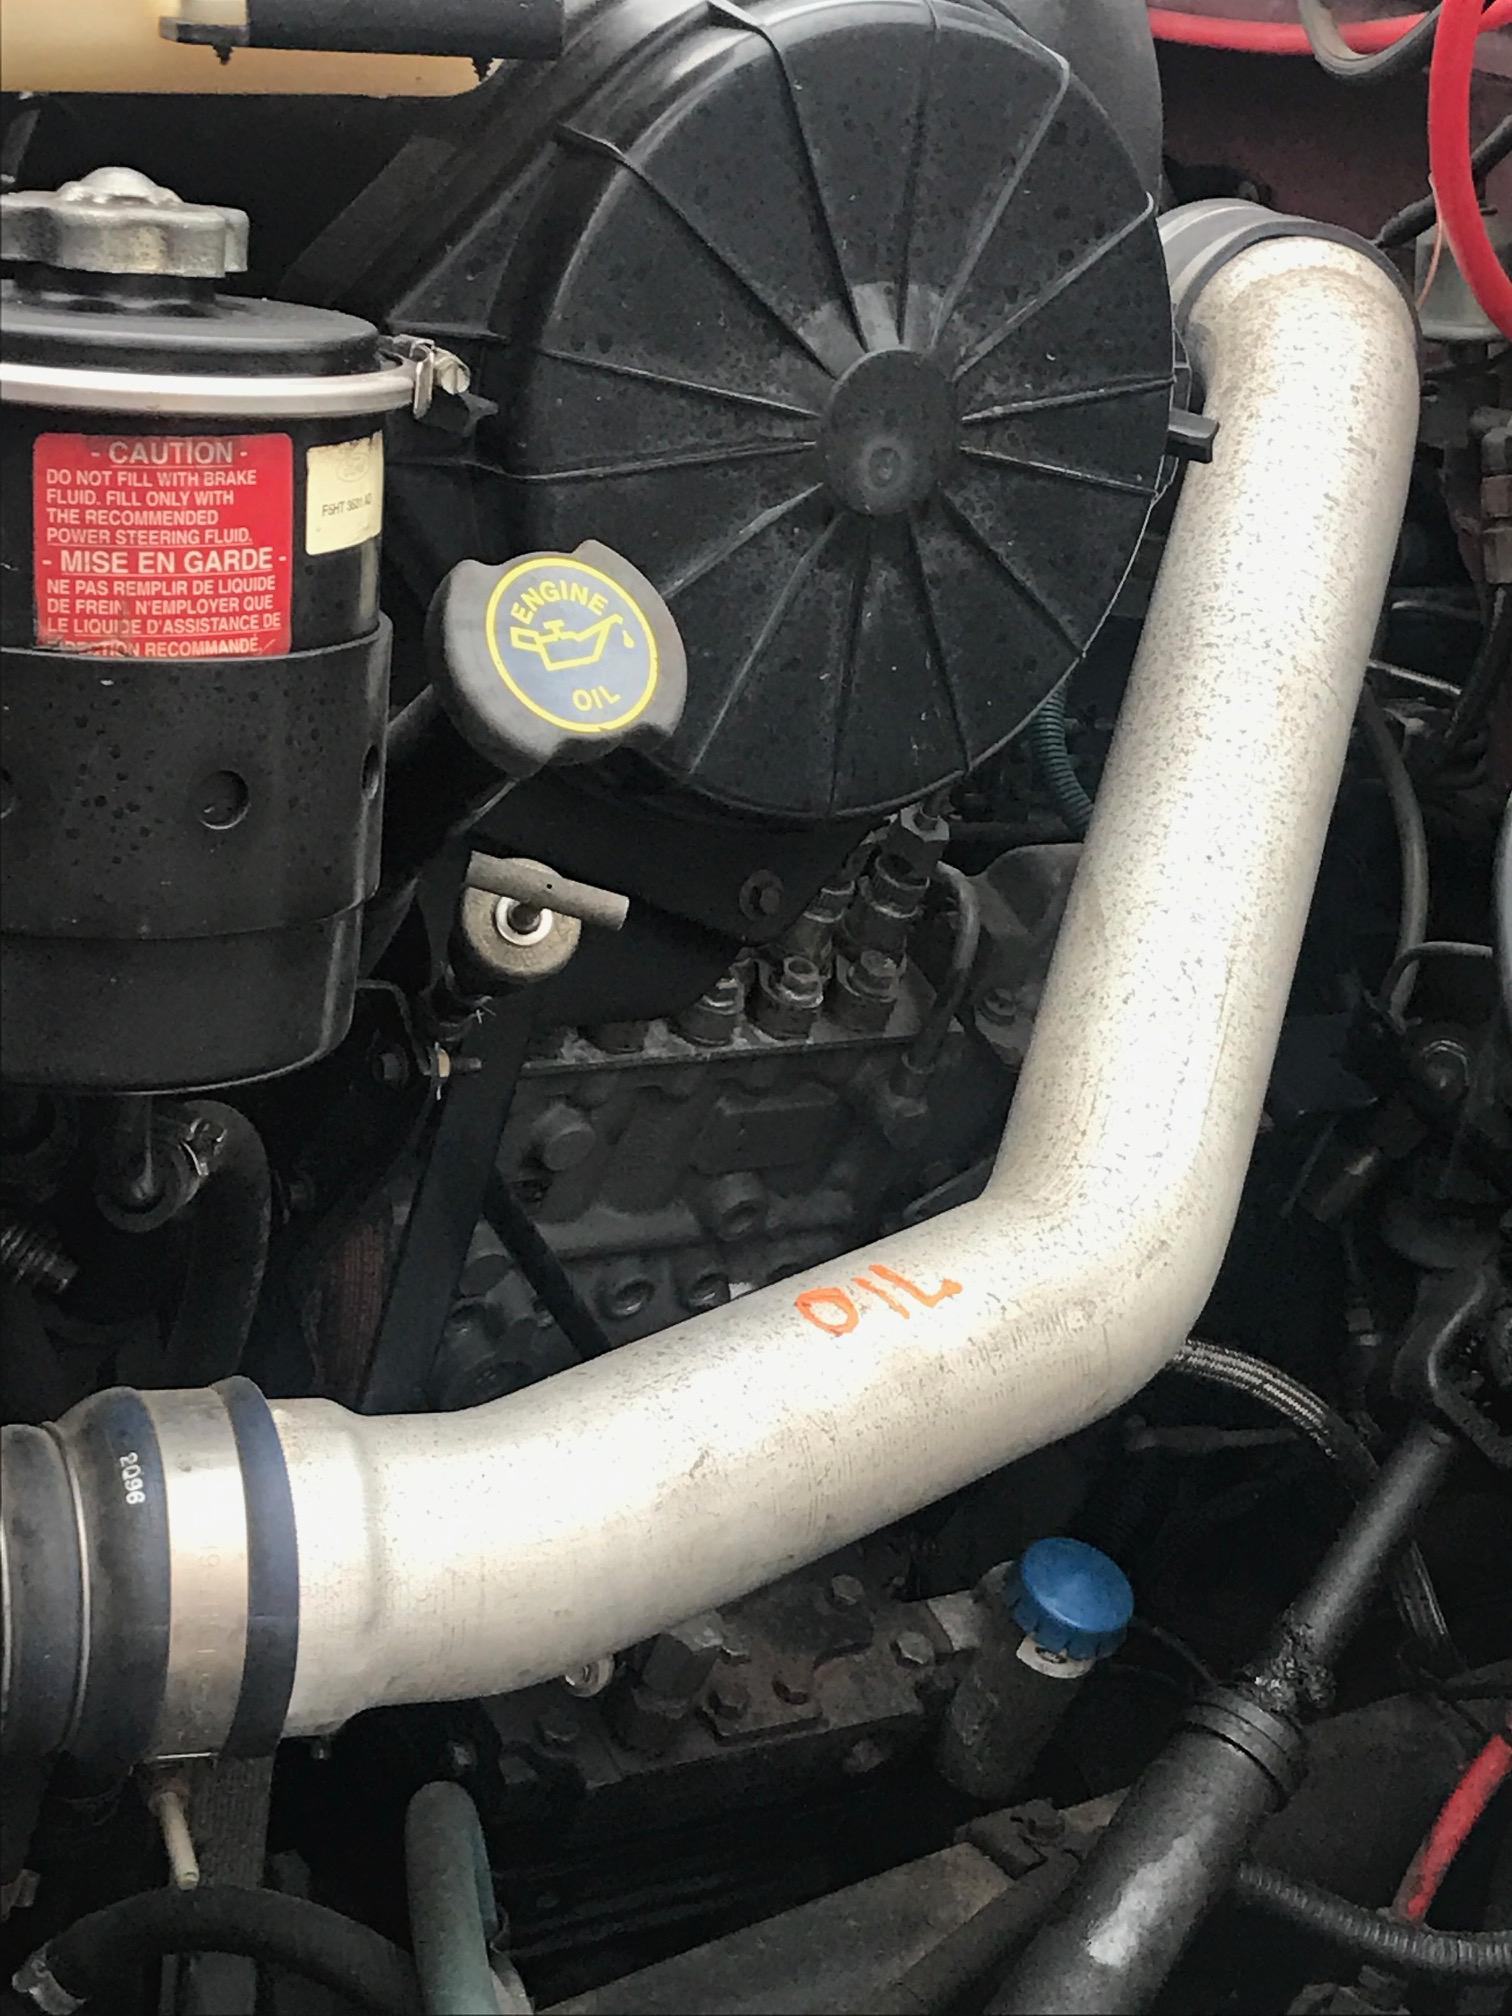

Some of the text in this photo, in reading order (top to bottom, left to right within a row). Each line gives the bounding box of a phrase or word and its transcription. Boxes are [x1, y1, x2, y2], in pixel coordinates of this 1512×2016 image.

[109, 441, 233, 464] CAUTION
[46, 468, 257, 487] DO NOT FILL WITH BRAKE
[46, 488, 234, 507] FLUID. FILL ONLY WITH
[46, 507, 219, 526] THE RECOMMENDED
[47, 527, 252, 545] POWER STEERING FLUID.
[60, 549, 128, 573] MISE
[138, 551, 175, 573] EN
[184, 546, 273, 573] GARDE
[47, 575, 276, 596] NE PAS REMPLIR DE LIQUIDE
[47, 598, 71, 614] DE
[135, 597, 240, 616] N'EMPLOYER
[243, 594, 273, 612] QUE
[511, 579, 609, 625] ENGINE
[47, 612, 281, 635] LE LIQUIDE D'ASSISTANCE DE
[572, 685, 622, 712] OIL
[793, 1263, 964, 1338] OIL
